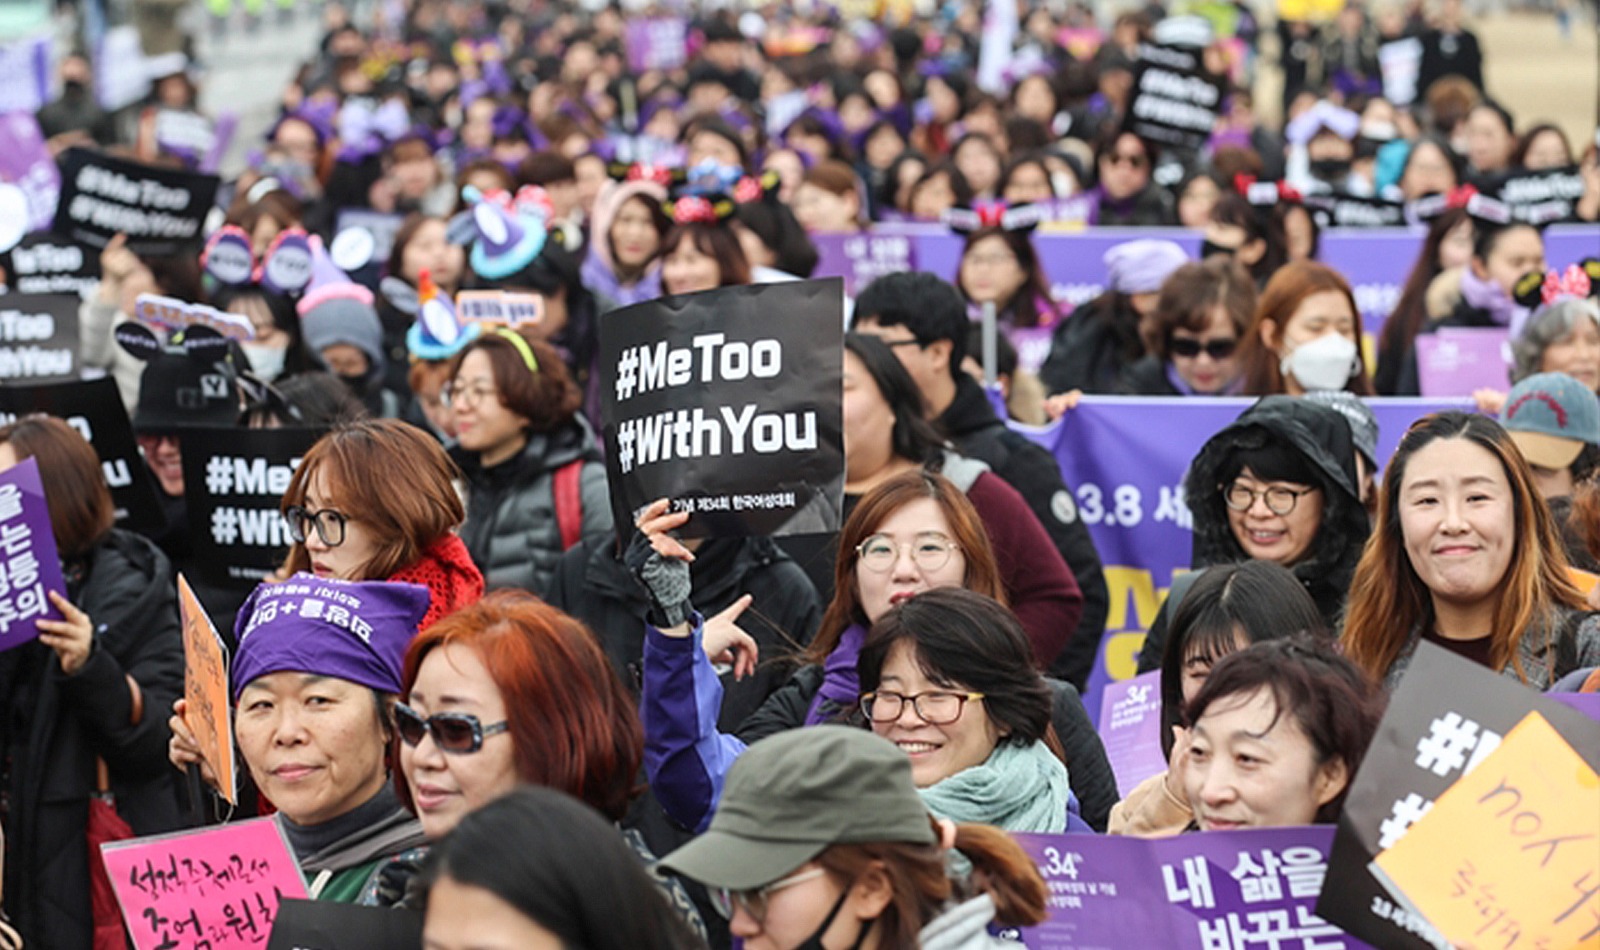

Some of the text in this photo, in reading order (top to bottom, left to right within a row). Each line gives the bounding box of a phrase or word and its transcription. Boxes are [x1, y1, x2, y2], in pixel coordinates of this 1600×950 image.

[76, 165, 191, 210] #MeToo
[616, 333, 781, 400] #MeToo
[617, 405, 817, 474] #WithYou
[698, 497, 730, 511] 제34회
[733, 493, 795, 509] 한국여성대회
[1076, 483, 1143, 527] 3.8
[1161, 846, 1328, 909] 내 삶을
[1198, 905, 1345, 950] 바꾸는
